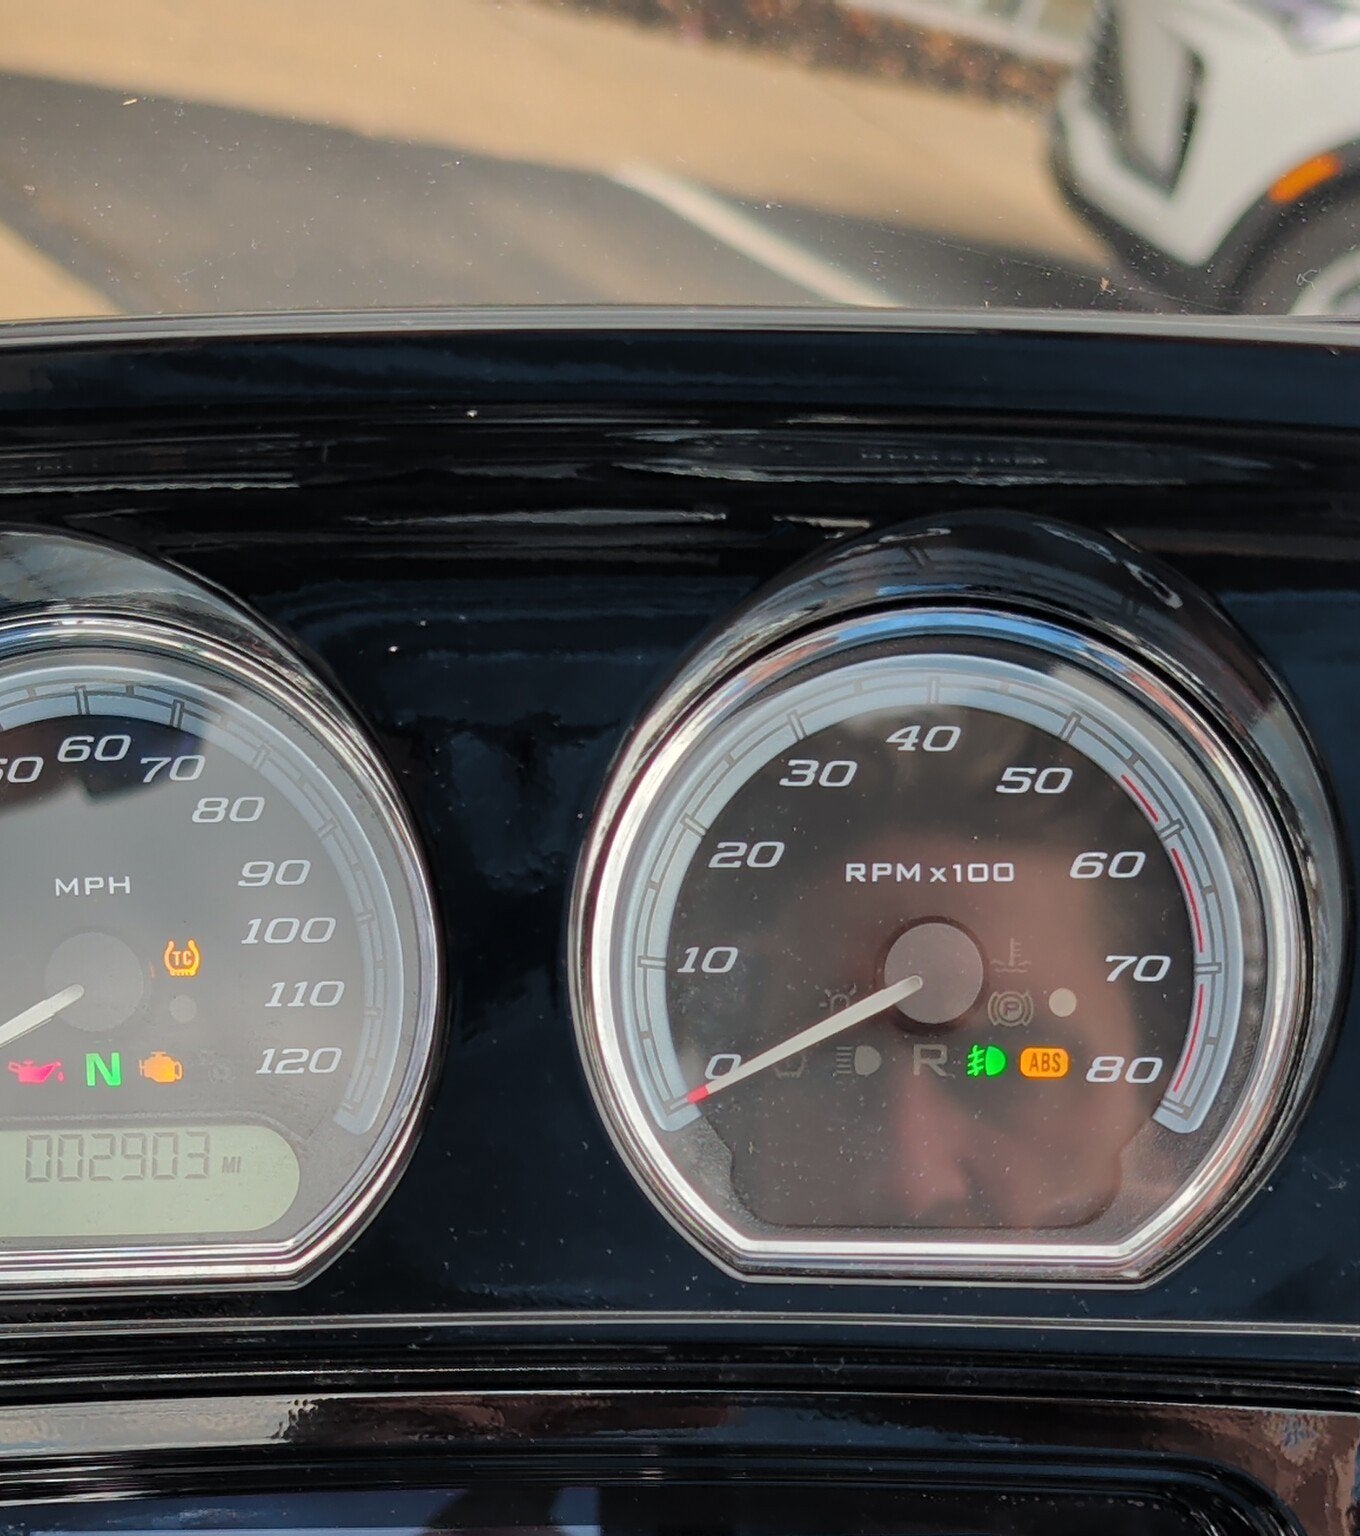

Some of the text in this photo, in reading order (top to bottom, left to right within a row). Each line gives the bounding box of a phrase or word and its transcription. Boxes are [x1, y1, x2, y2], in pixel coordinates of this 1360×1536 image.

[57, 734, 132, 763] 60
[885, 725, 961, 753] 40
[140, 755, 205, 783] 70
[780, 759, 858, 788] 30
[996, 766, 1073, 794] 50
[192, 797, 264, 824] 80
[708, 841, 785, 869] 20
[1069, 851, 1147, 879] 60
[54, 875, 132, 897] MPH
[238, 859, 311, 888] 90
[241, 917, 336, 944] 100
[171, 950, 193, 966] TC
[676, 946, 738, 974] 10
[1104, 955, 1171, 983] 70
[265, 980, 345, 1008] 110
[85, 1052, 122, 1086] N
[254, 1047, 342, 1075] 120
[704, 1053, 742, 1080] 0
[1028, 1052, 1062, 1073] ABS
[1085, 1056, 1164, 1084] 80
[25, 1131, 210, 1183] 002903
